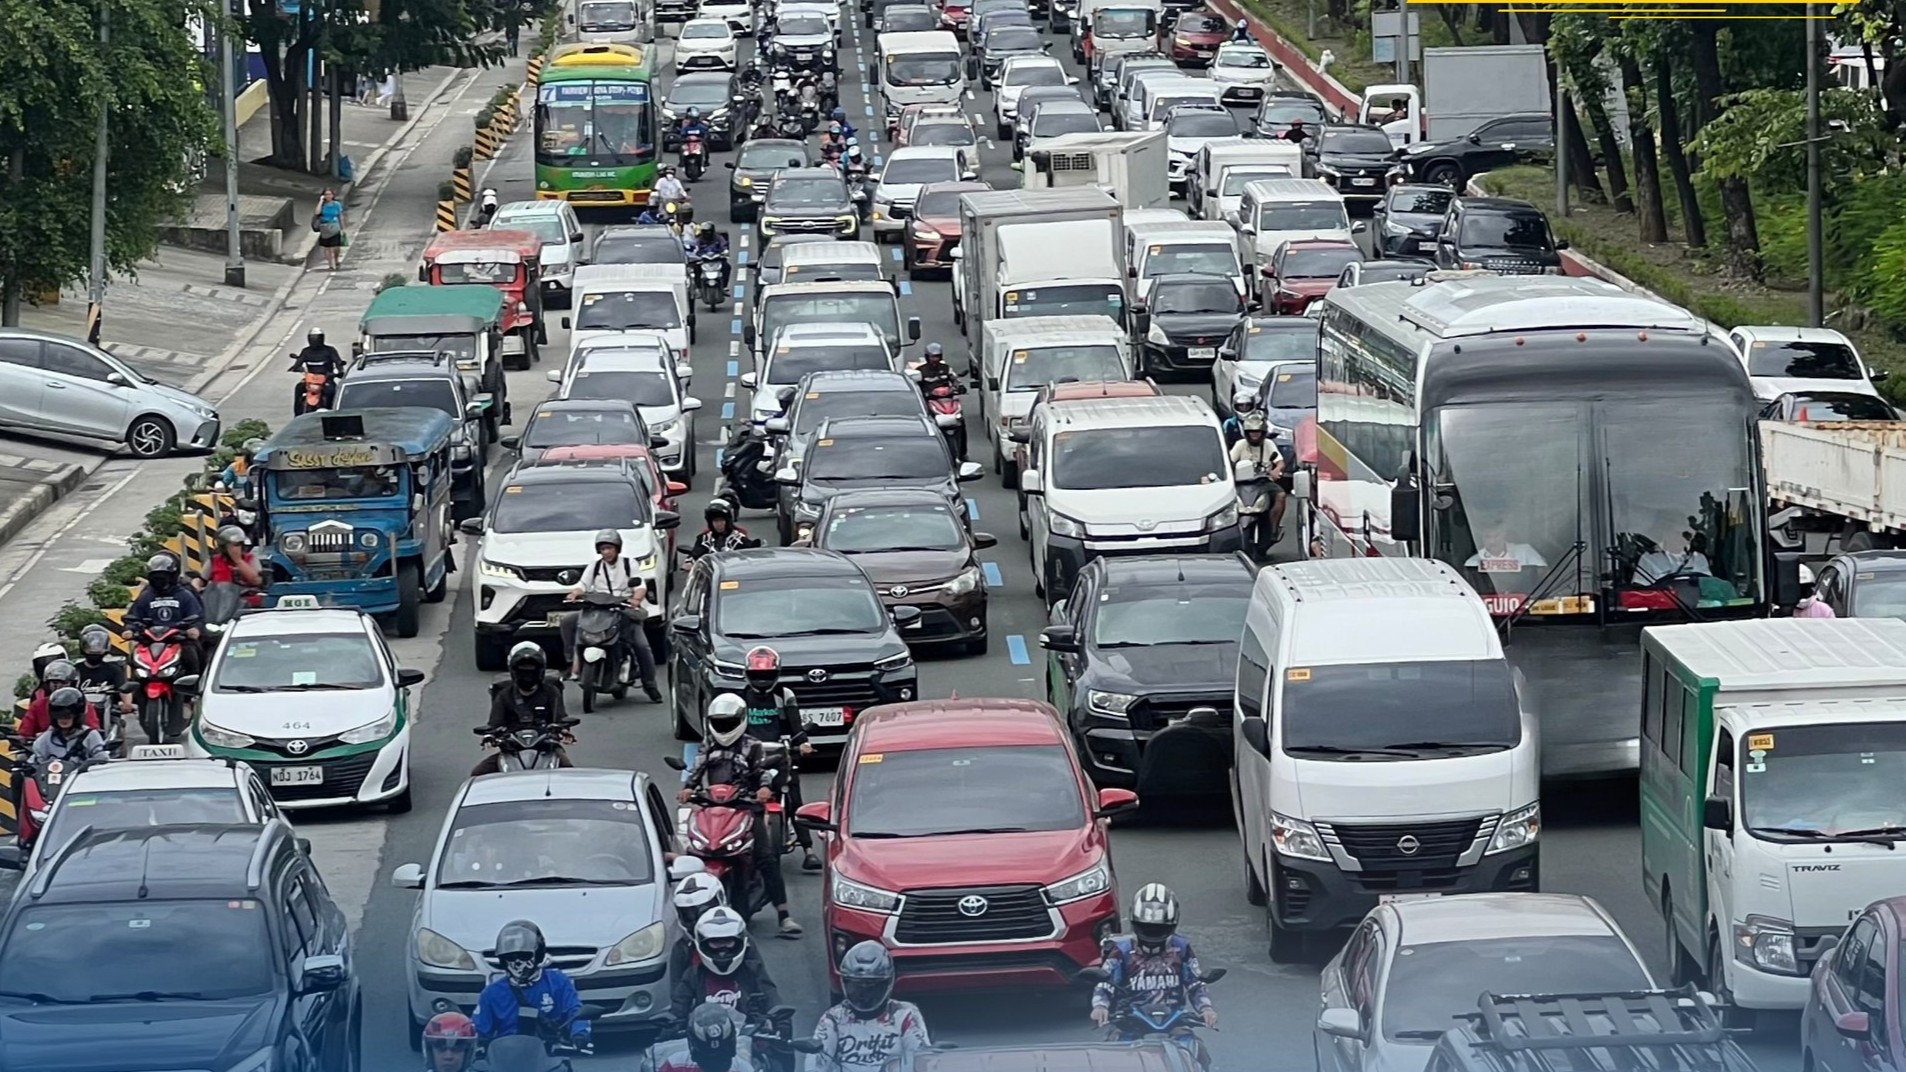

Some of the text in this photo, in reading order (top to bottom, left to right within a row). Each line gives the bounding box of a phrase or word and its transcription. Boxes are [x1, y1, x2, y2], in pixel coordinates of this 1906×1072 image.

[542, 87, 555, 99] 7
[1481, 560, 1518, 571] EXPRESS
[819, 712, 842, 722] 7607
[282, 721, 311, 730] 464
[140, 748, 178, 758] TAXI
[297, 770, 321, 781] 1764
[1792, 864, 1841, 873] TRAVIZ
